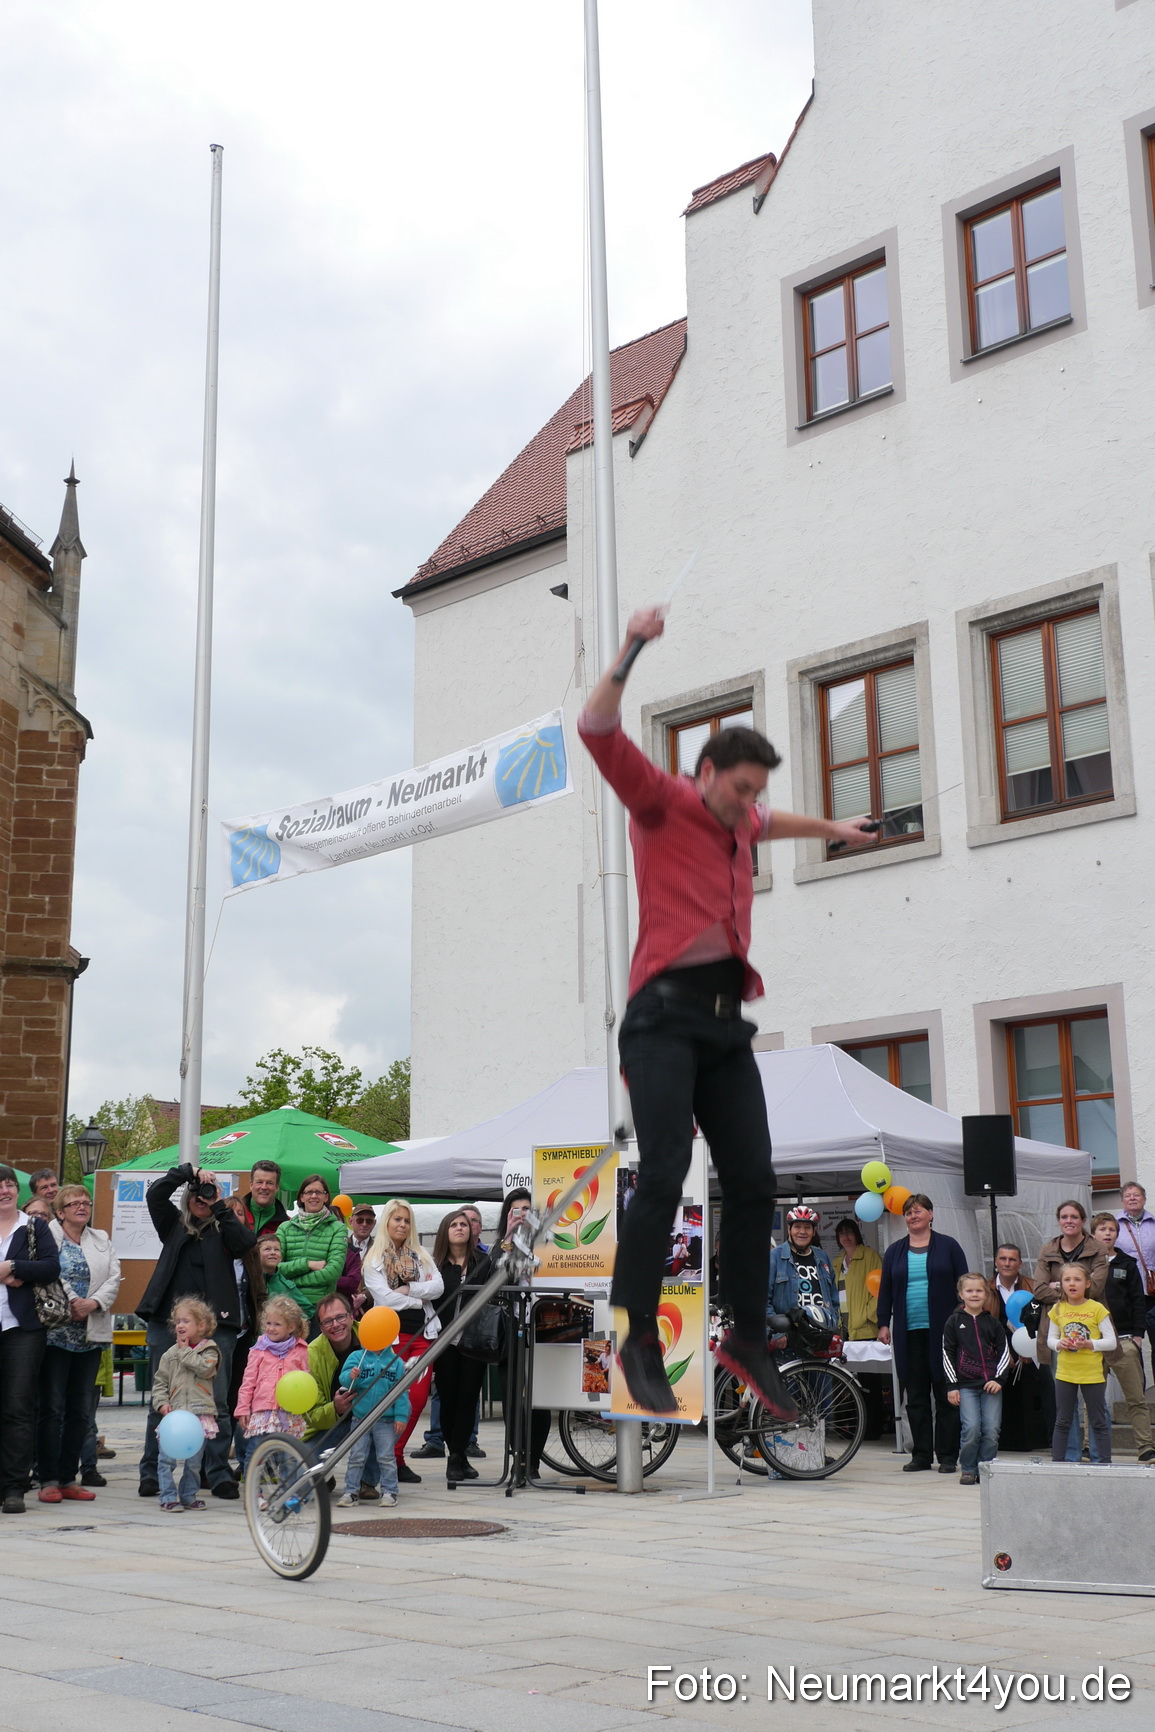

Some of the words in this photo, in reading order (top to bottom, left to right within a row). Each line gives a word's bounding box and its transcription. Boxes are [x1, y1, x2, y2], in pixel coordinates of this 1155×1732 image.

[275, 797, 372, 841] Sozialraum
[386, 750, 488, 808] Neumarkt
[362, 822, 386, 835] offene
[388, 794, 462, 826] Behindertenarbeit
[328, 844, 367, 862] Landkreis
[365, 832, 407, 850] Neumarkt
[542, 1149, 612, 1161] SYMPATHIEBLU
[543, 1177, 565, 1185] BEIRAT
[552, 1253, 564, 1261] FÜR
